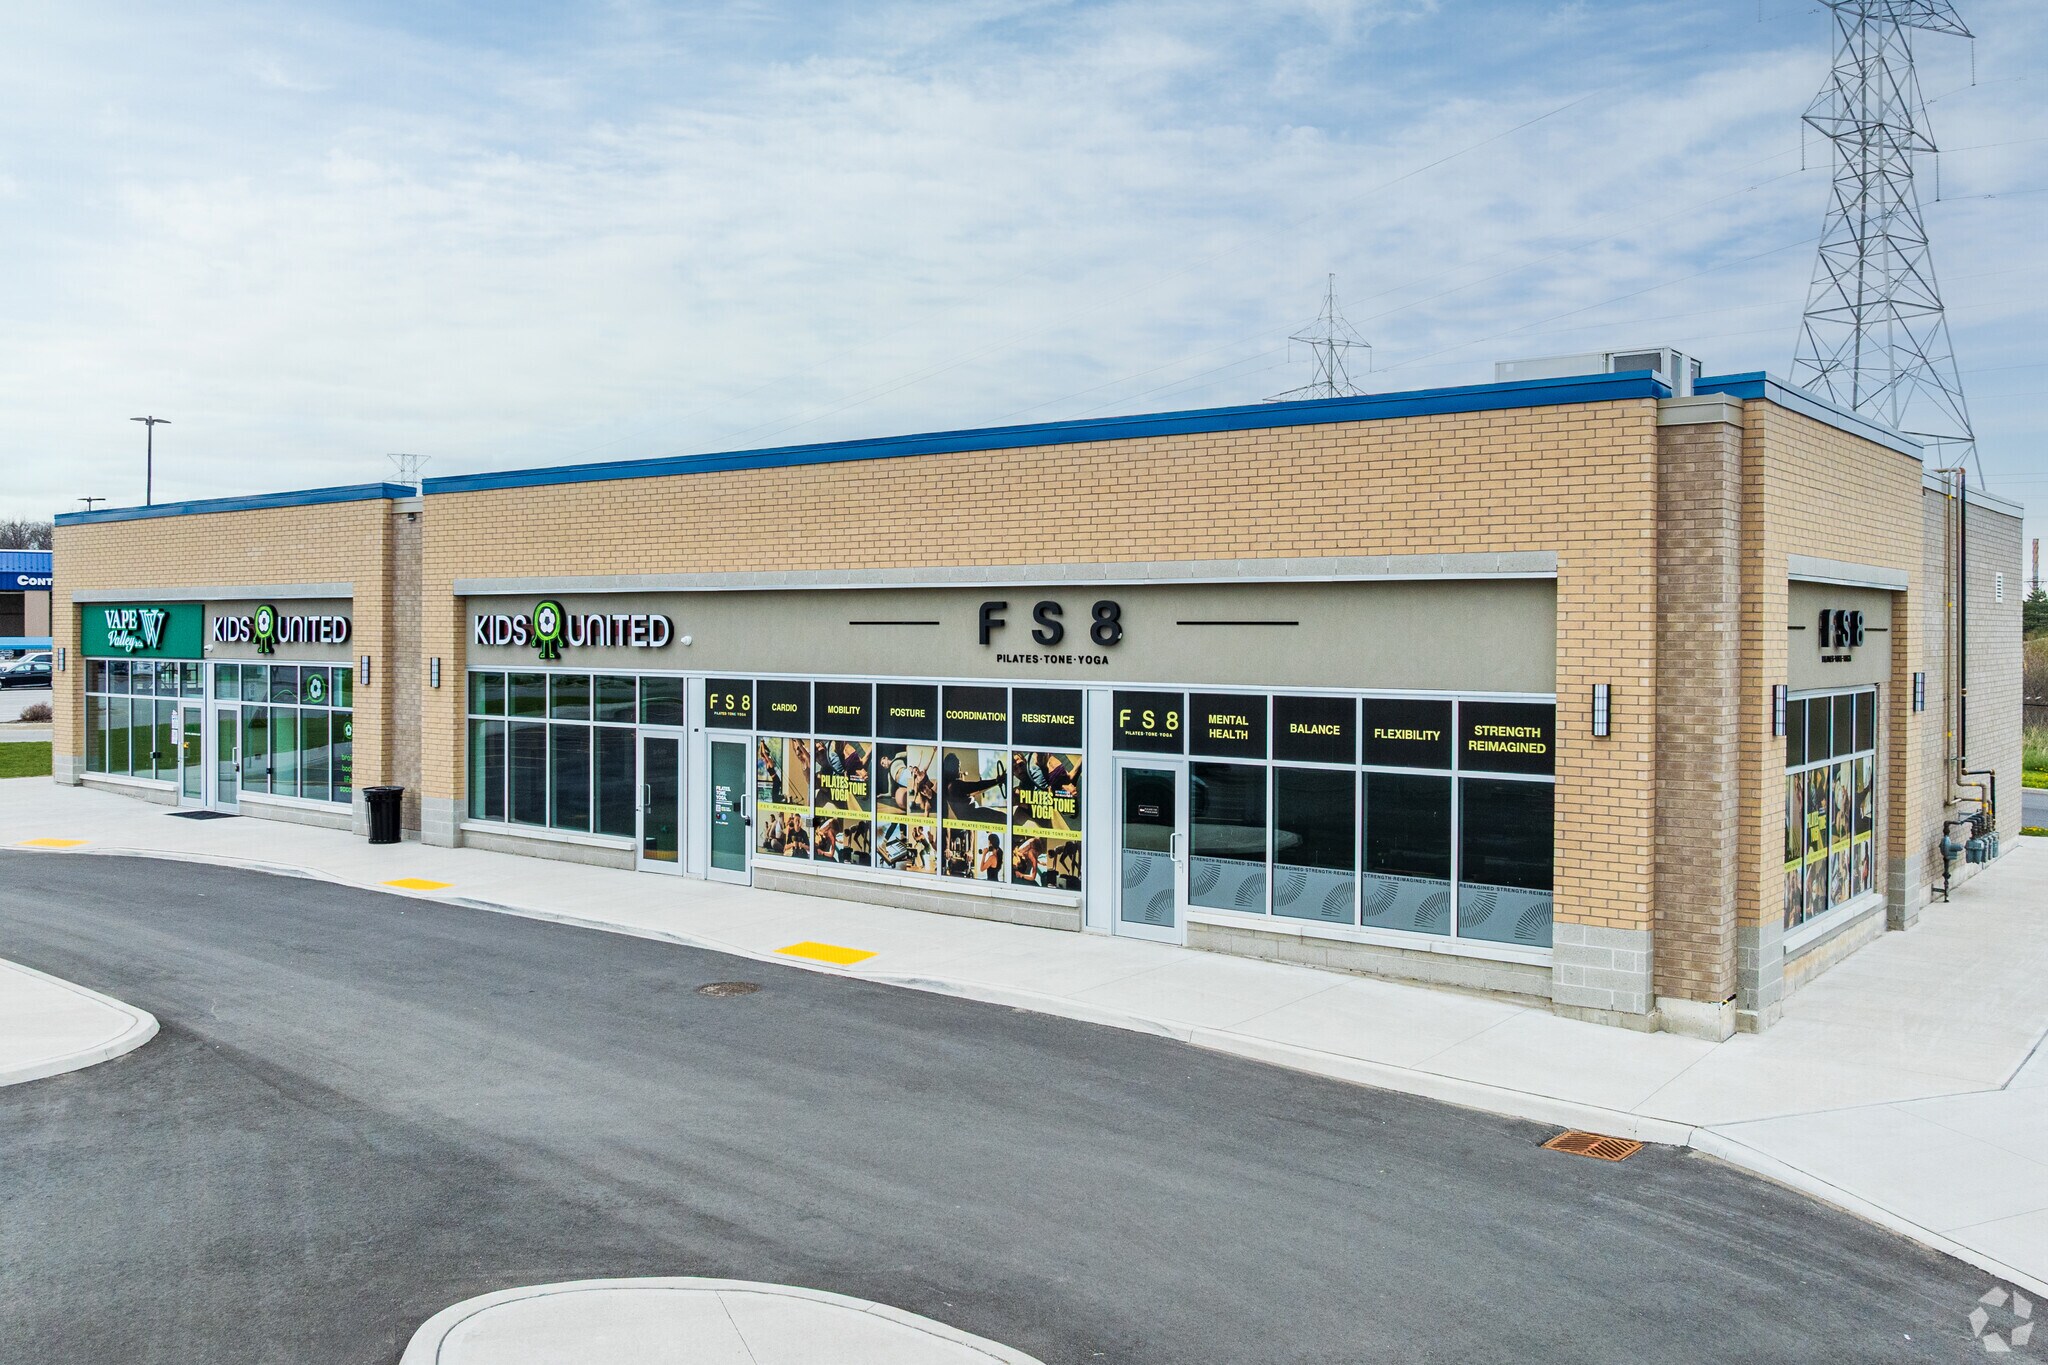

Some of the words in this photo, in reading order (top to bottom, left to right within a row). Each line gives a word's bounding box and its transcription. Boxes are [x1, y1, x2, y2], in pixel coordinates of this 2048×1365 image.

[104, 609, 138, 629] VAPE
[213, 616, 250, 642] KIDS
[277, 615, 347, 643] UNITED
[474, 614, 527, 646] KIDS
[567, 614, 670, 647] UNITED
[107, 630, 135, 652] Valley
[996, 654, 1039, 663] PILATES
[1043, 654, 1075, 664] TONE
[1078, 655, 1109, 665] YOGA
[771, 703, 798, 712] CARDIO
[827, 705, 860, 715] MOBILITY
[890, 708, 925, 718] POSTURE
[946, 710, 1006, 722] COORDINATION
[1021, 713, 1075, 725] RESISTANCE
[1208, 714, 1249, 726] MENTAL
[1209, 728, 1249, 740] HEALTH
[1290, 723, 1341, 736] BALANCE
[1374, 728, 1441, 741] FLEXIBILITY
[1474, 725, 1541, 738] STRENGTH
[1468, 740, 1546, 754] REIMAGINED
[821, 774, 849, 789] PILATES
[831, 787, 849, 801] YOGA
[849, 781, 867, 796] TONE
[1020, 789, 1054, 806] PILATES
[1031, 804, 1054, 820] YOGA
[1053, 797, 1076, 814] TONE
[1363, 873, 1392, 881] STRENGTH
[1496, 886, 1528, 895] STRENGTH
